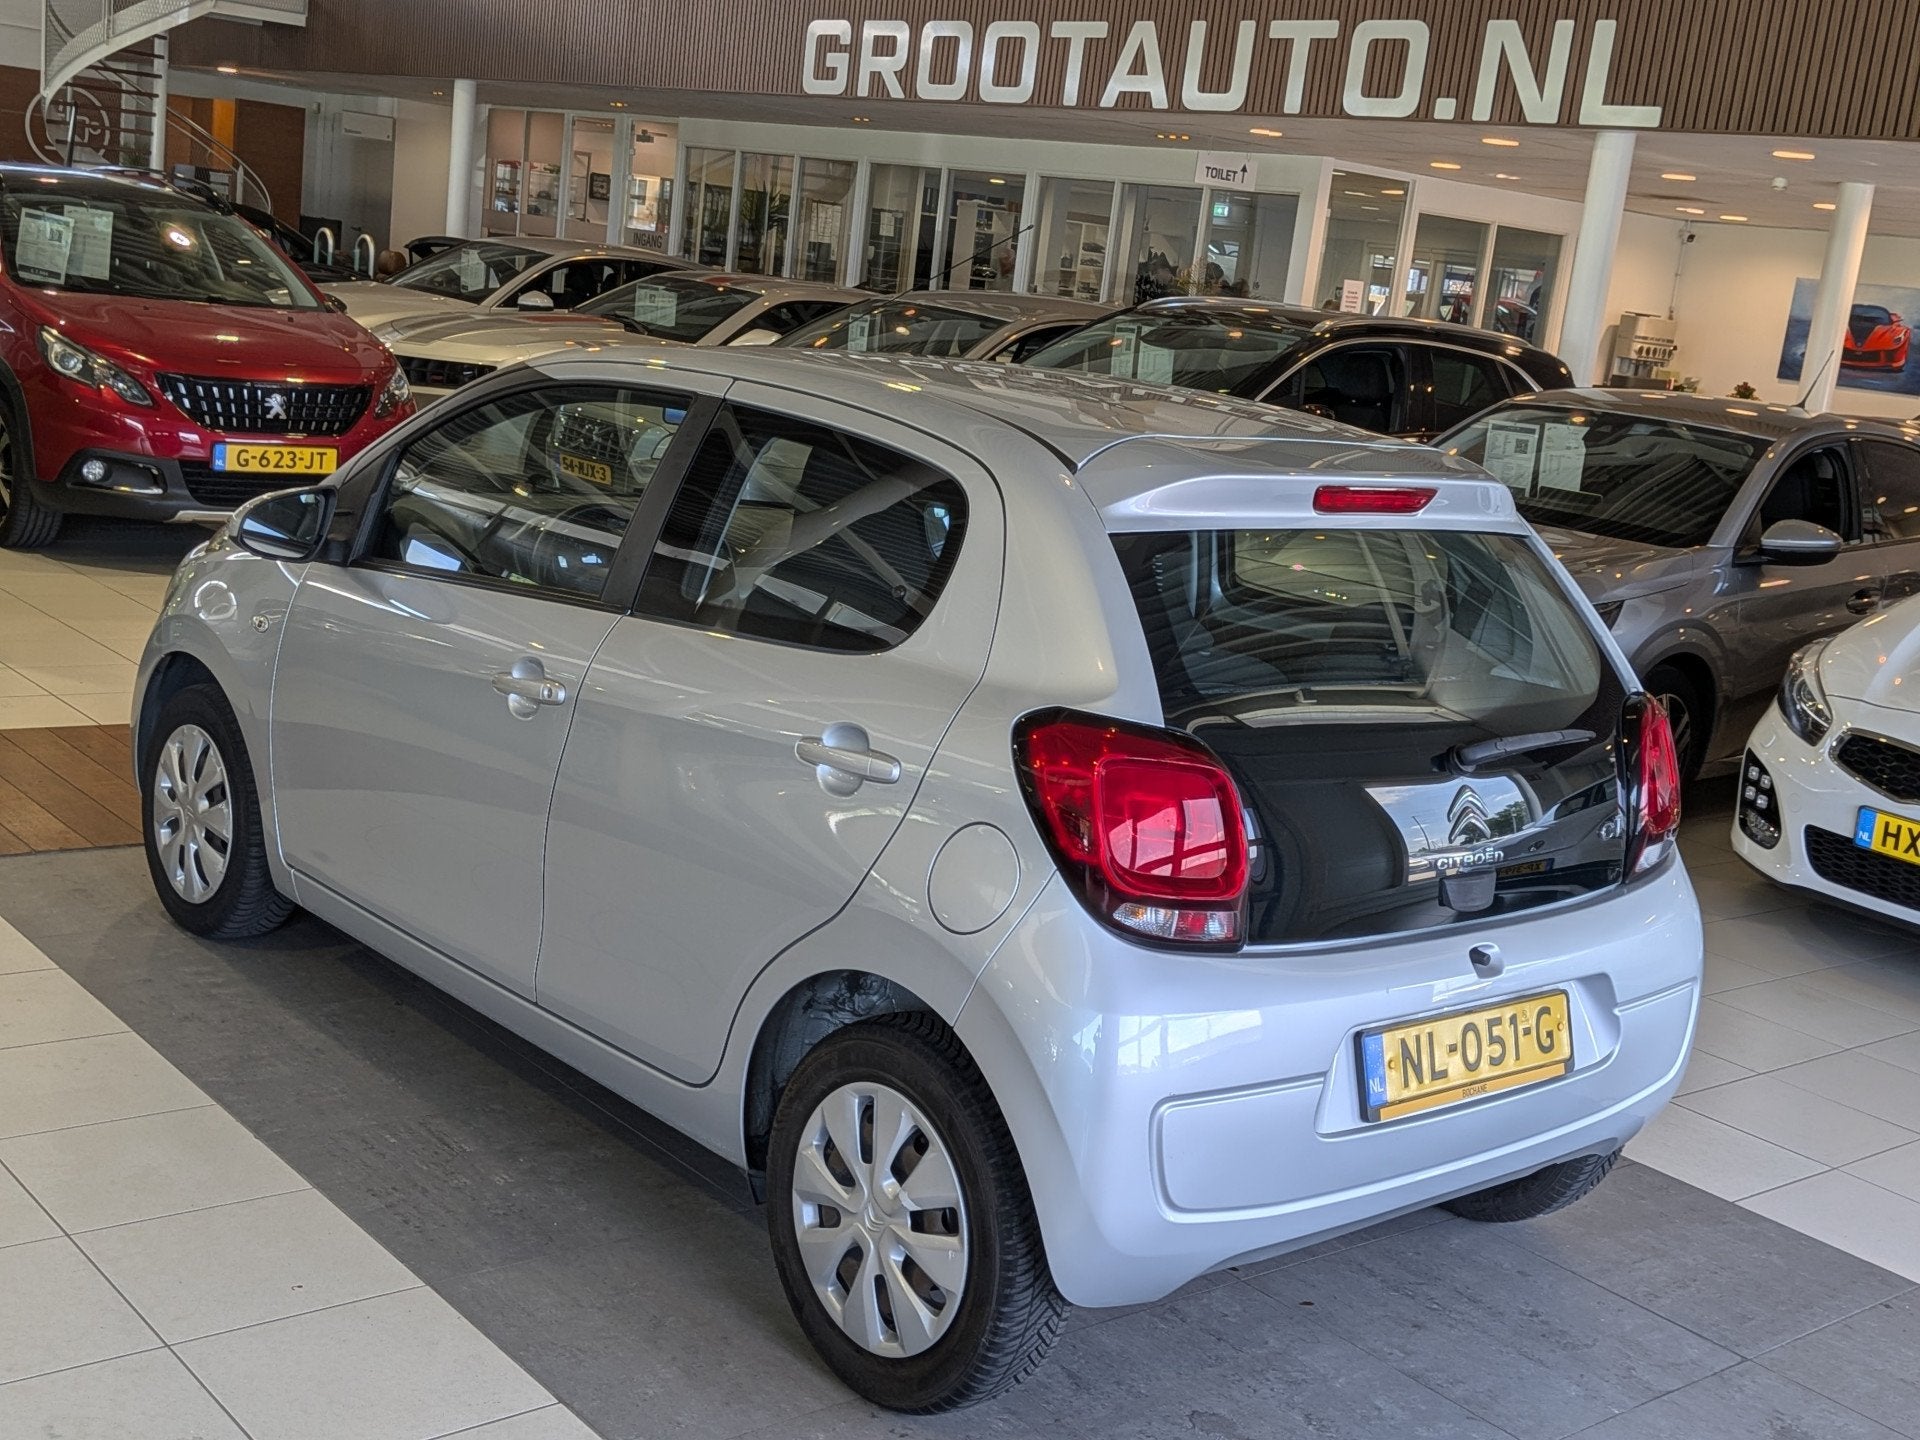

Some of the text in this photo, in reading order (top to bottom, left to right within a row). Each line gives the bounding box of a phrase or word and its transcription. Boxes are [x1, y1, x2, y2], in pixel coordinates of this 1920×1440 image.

[802, 19, 1662, 128] GROOTAUTO.NL
[1205, 166, 1238, 182] TOILET
[633, 232, 662, 249] INGANG
[236, 449, 327, 470] G-623-JT
[1858, 830, 1871, 842] NL
[1436, 847, 1504, 871] CITROËN
[1400, 1006, 1554, 1089] NL-051-G
[1369, 1078, 1384, 1094] NL
[1462, 1084, 1488, 1099] BOCHANE
